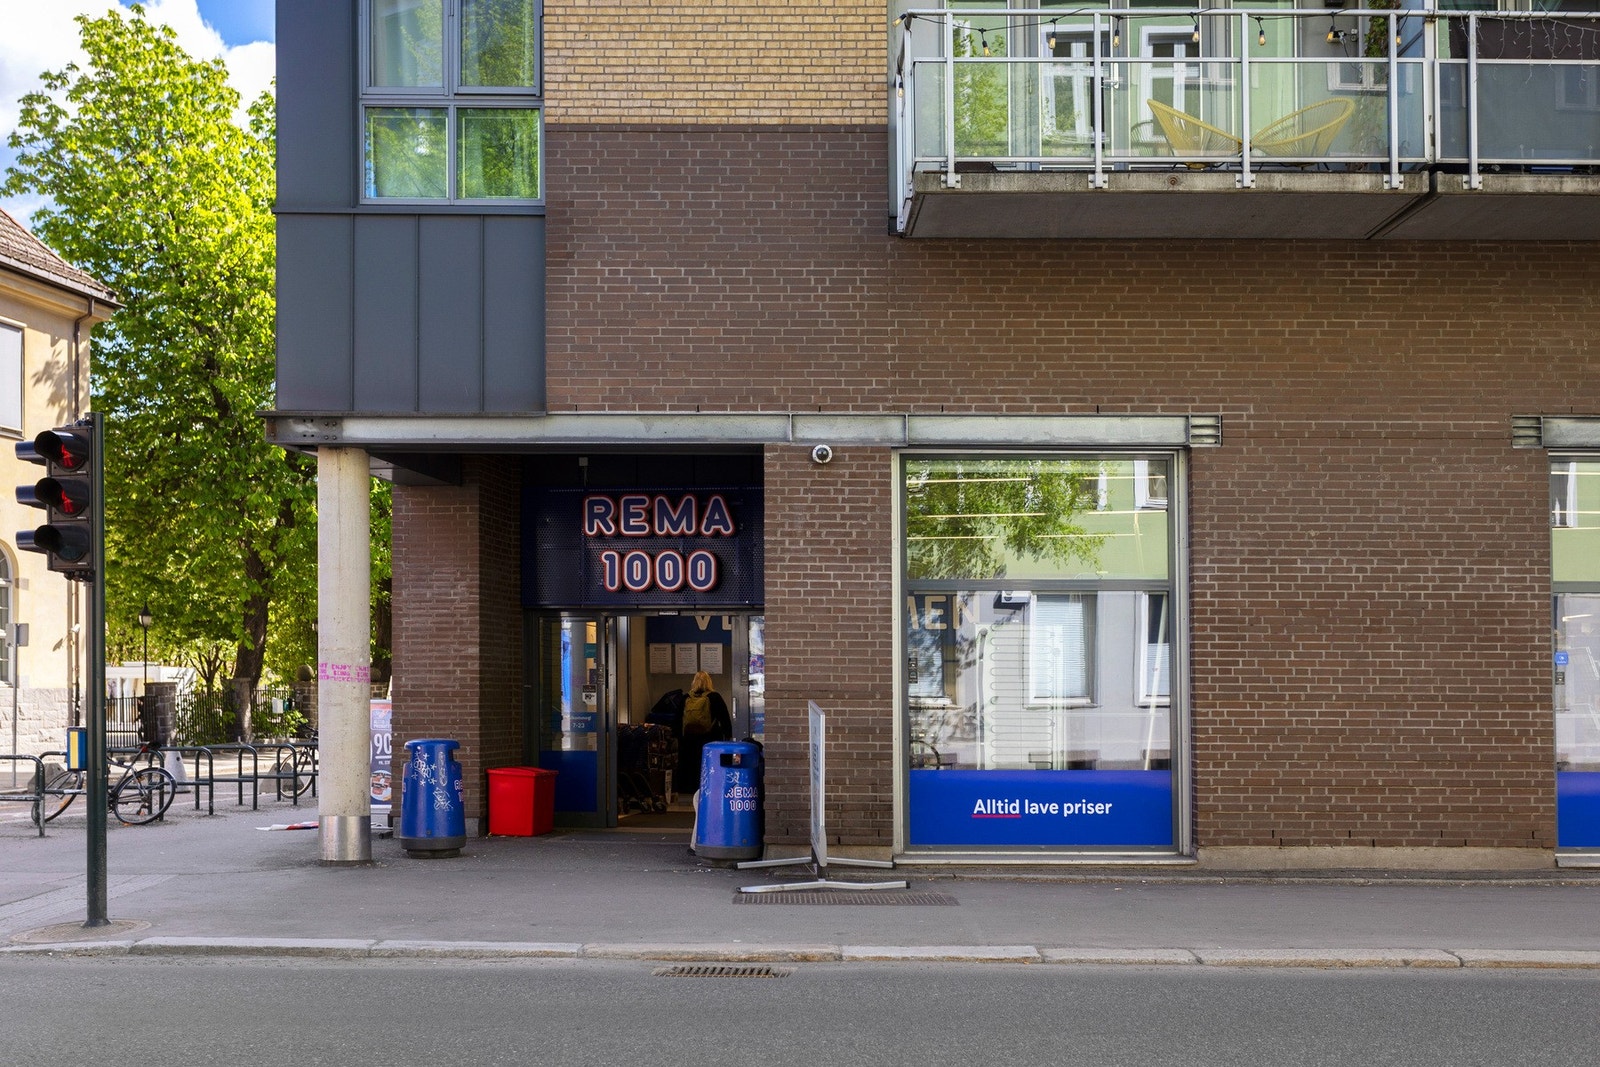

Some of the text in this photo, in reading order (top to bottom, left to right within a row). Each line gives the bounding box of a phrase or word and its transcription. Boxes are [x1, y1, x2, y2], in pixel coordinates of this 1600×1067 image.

[583, 494, 735, 537] REMA
[600, 549, 717, 592] 1000
[724, 786, 759, 799] REMA
[729, 799, 757, 812] 1000
[973, 799, 1113, 817] Alltid lave priser
